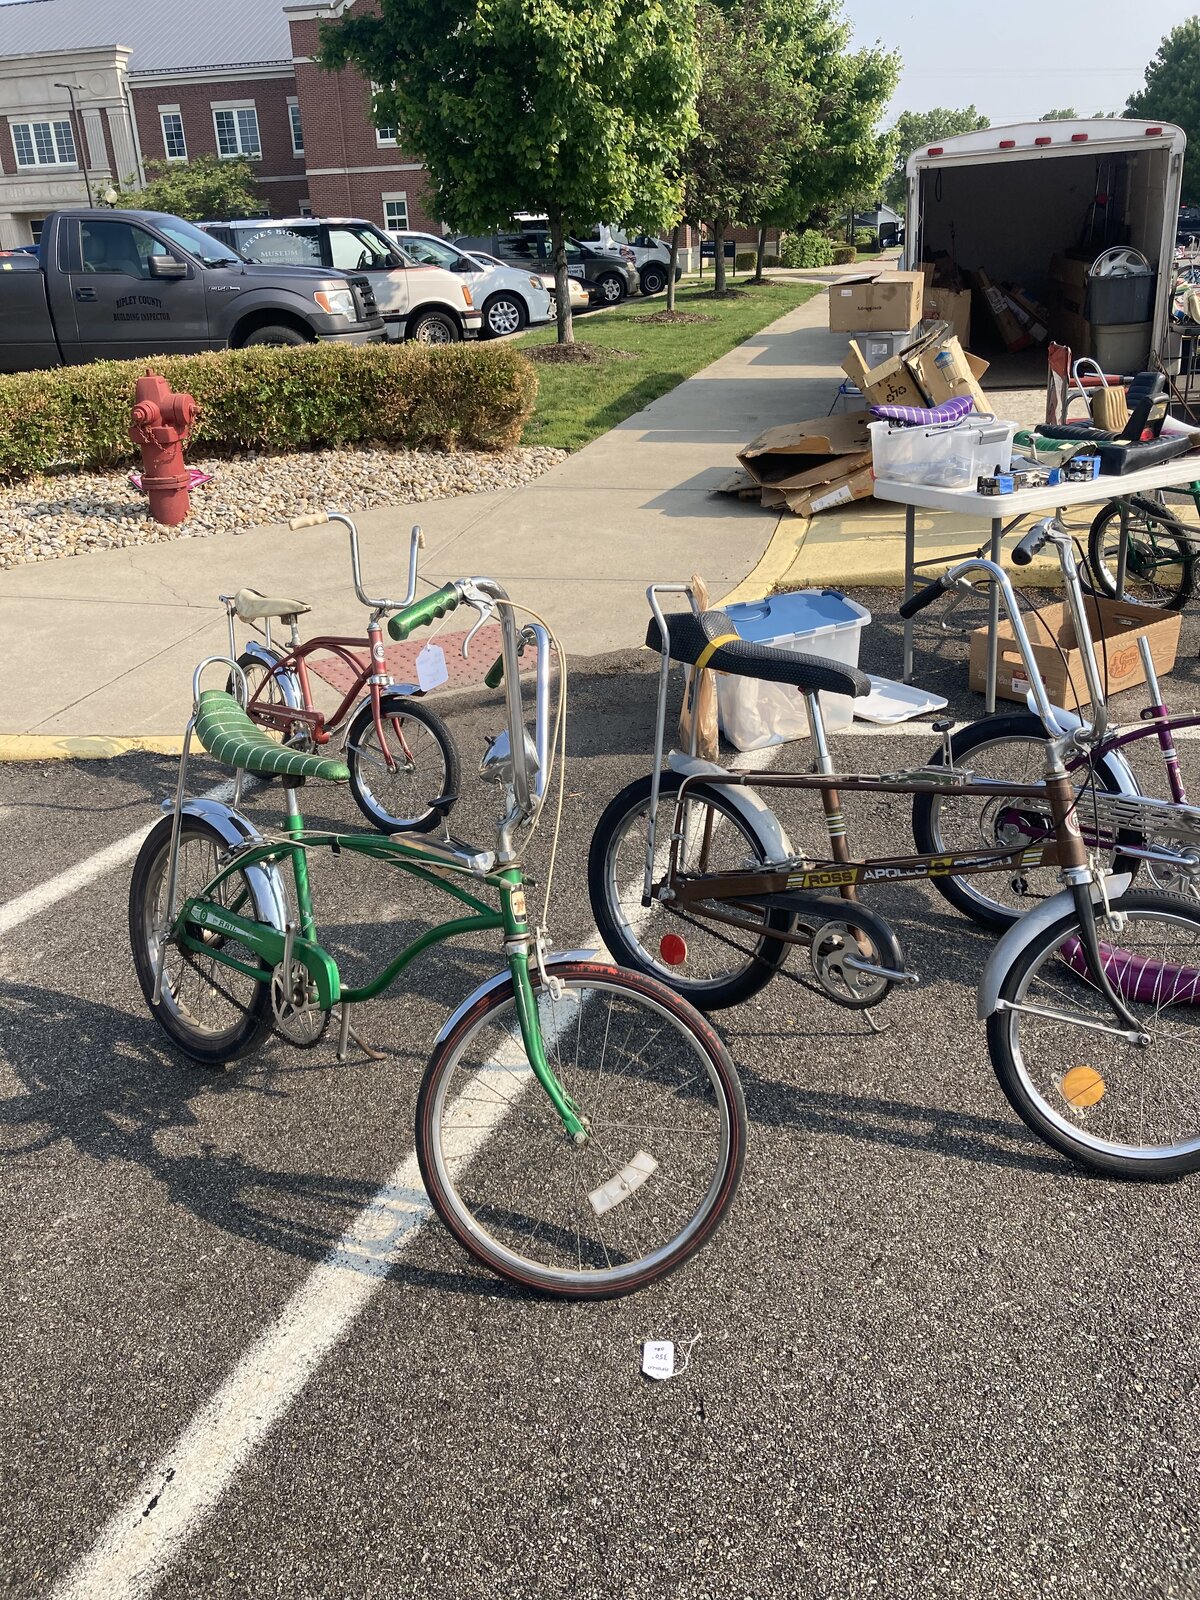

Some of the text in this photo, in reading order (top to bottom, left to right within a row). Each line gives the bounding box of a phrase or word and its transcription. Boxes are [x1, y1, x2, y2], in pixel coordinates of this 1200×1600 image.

[241, 229, 273, 252] STEVE'S
[260, 250, 298, 258] MUSEUM
[116, 295, 162, 309] RIPLEY COUNTY
[141, 312, 171, 321] INSPECTOR
[808, 872, 853, 887] ROSS
[863, 864, 928, 880] APOLLO
[218, 920, 238, 932] RAIL
